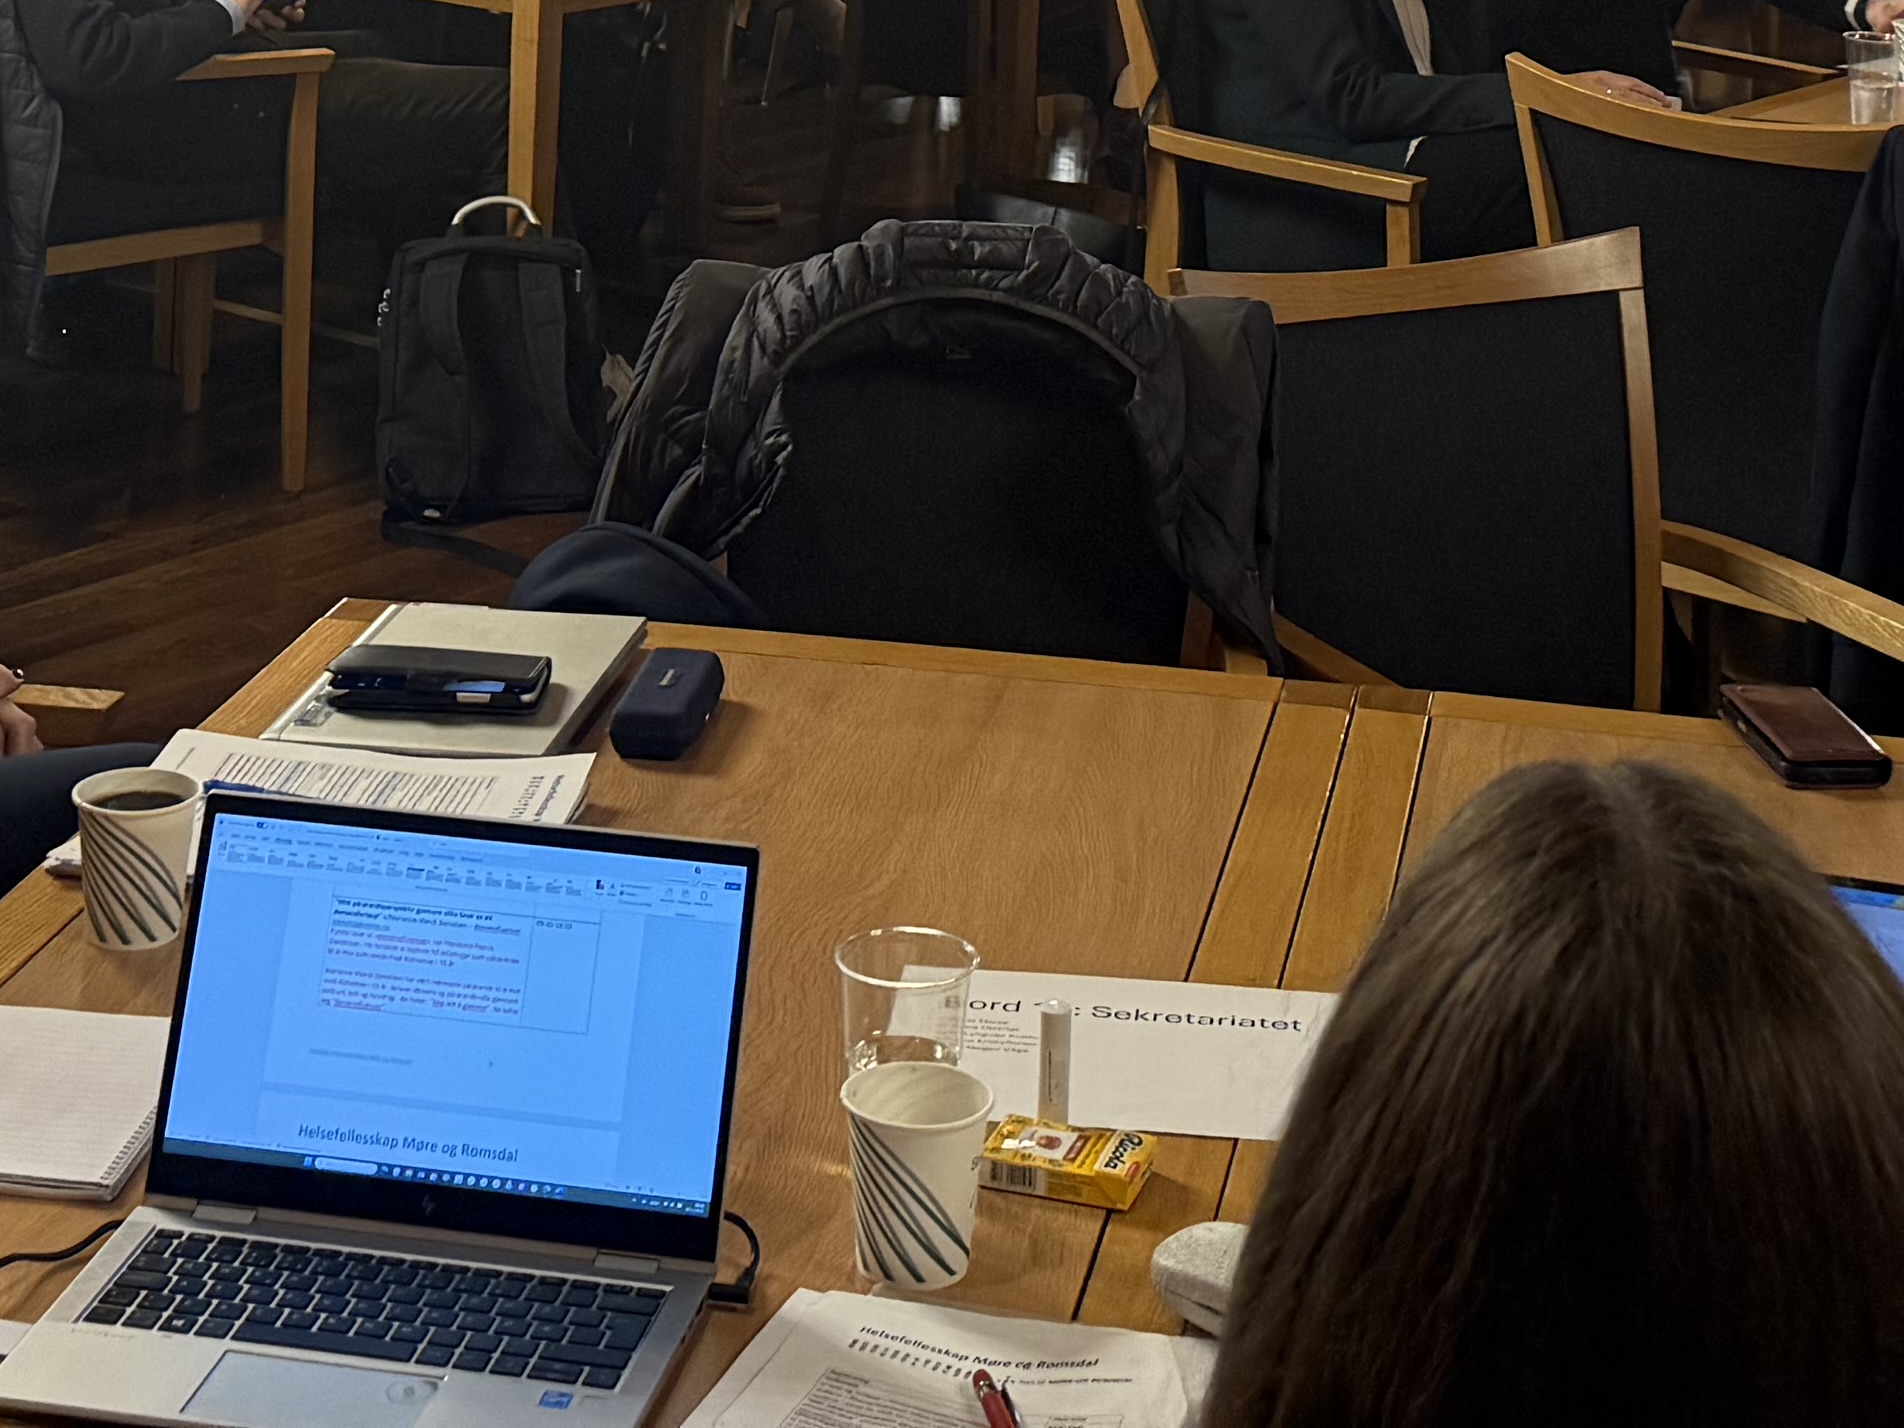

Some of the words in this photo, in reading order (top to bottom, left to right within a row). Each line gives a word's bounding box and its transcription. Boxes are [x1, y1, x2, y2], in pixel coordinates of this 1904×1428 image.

[1090, 1005, 1303, 1032] Sekretariatet
[297, 1123, 399, 1151] Helsefellesskap
[402, 1136, 438, 1153] Møre
[441, 1143, 458, 1159] og
[461, 1143, 520, 1163] Romsdal
[1103, 1132, 1144, 1170] Ricola
[859, 1325, 970, 1362] Helsefellesskap
[1036, 1357, 1100, 1370] Romsdal
